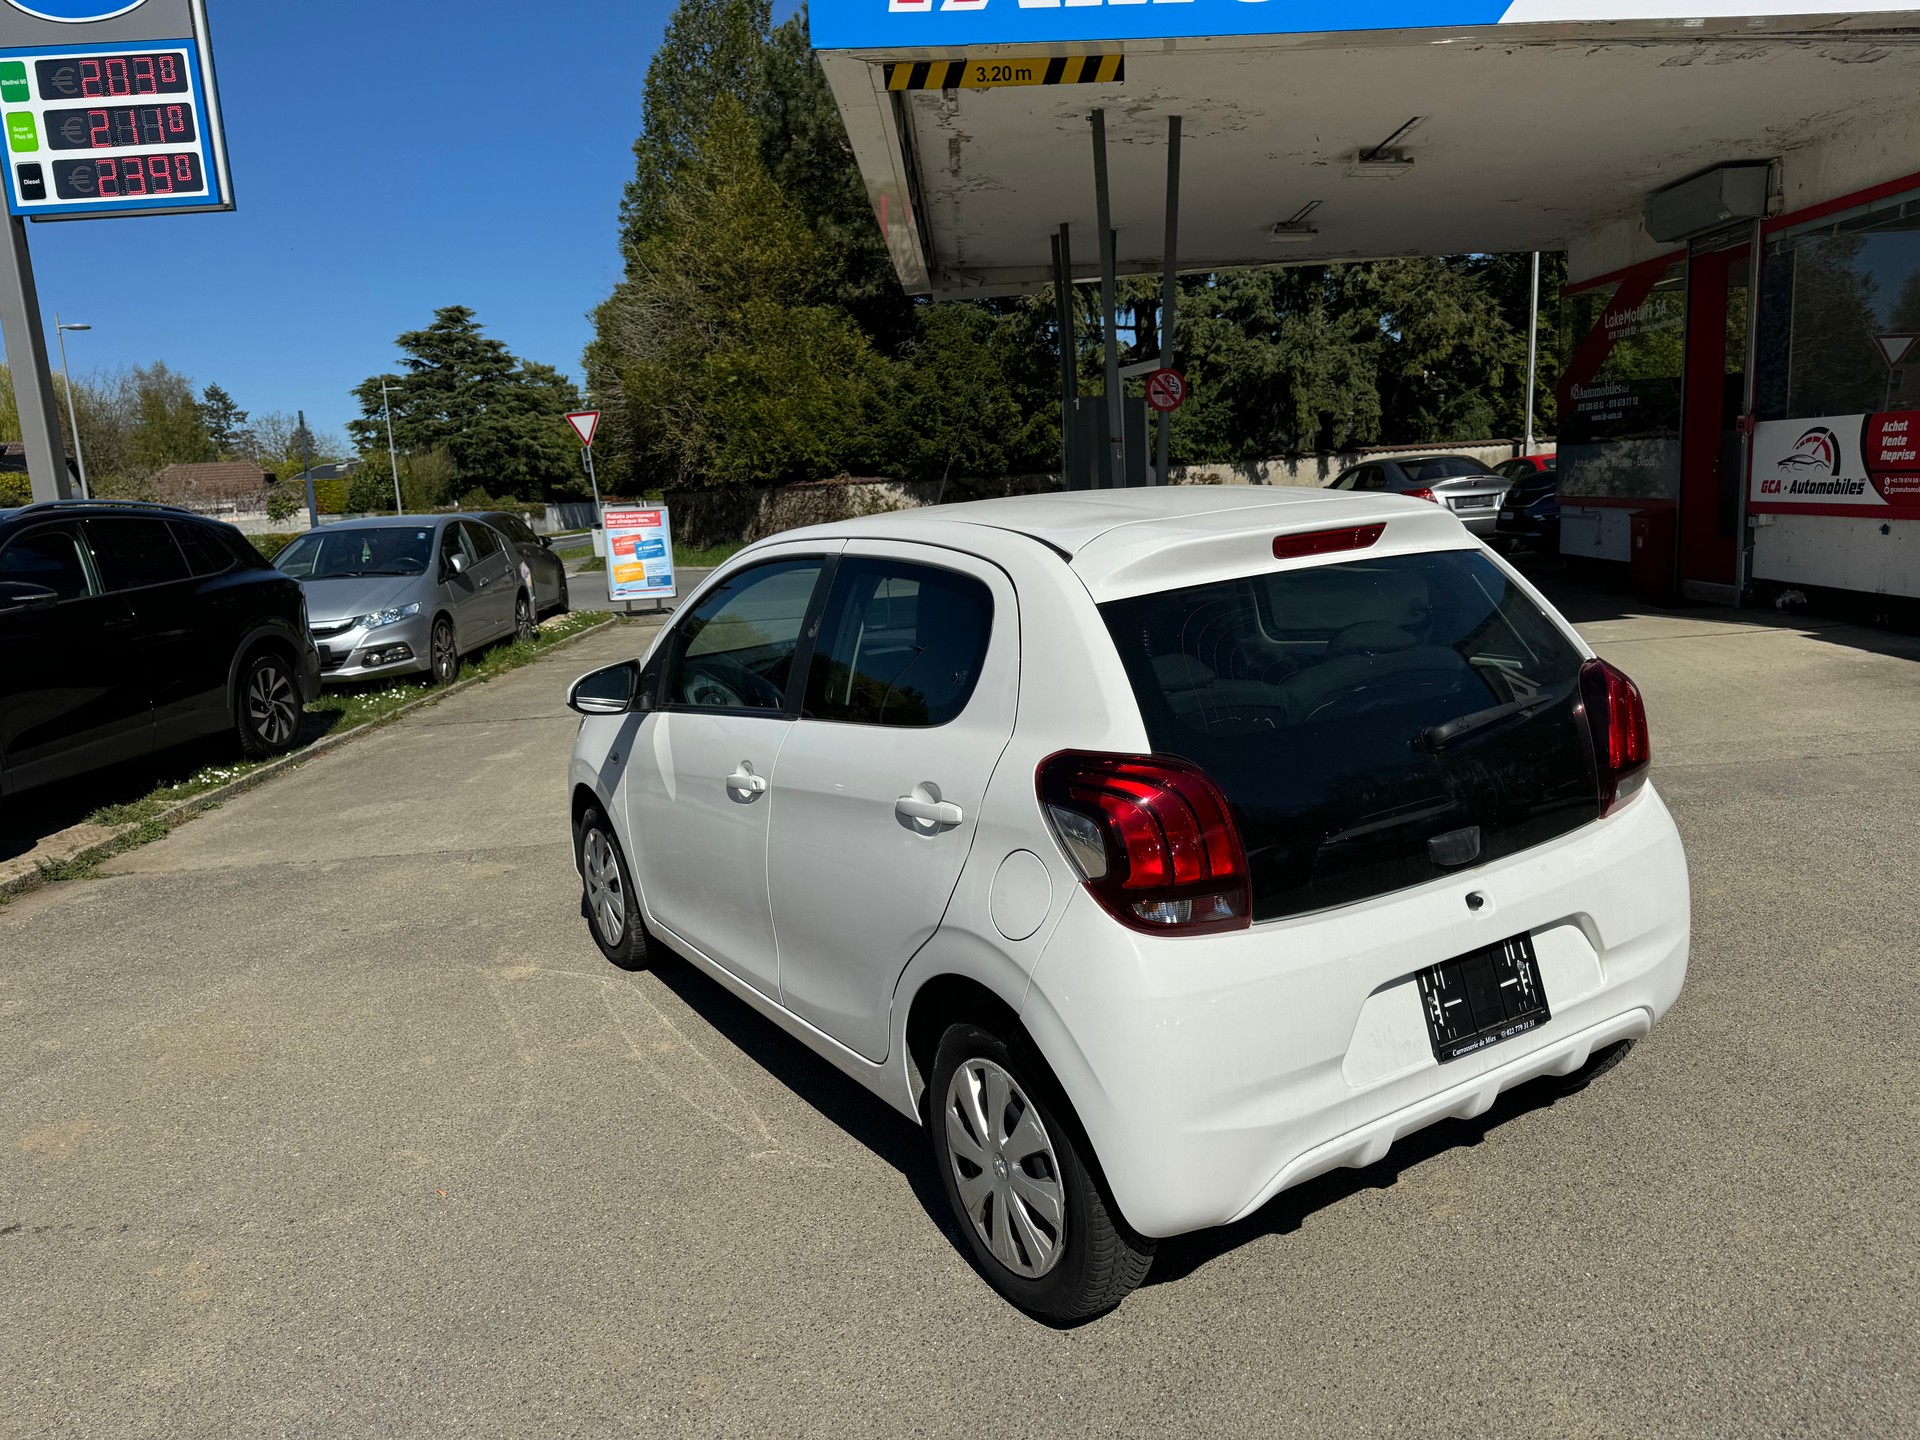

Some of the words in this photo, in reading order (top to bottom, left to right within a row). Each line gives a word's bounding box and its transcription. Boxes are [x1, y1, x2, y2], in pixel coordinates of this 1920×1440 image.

[975, 66, 1013, 83] 3.20
[1015, 68, 1032, 81] m
[1604, 304, 1653, 329] LakeMotors
[1655, 299, 1667, 317] SA
[1578, 381, 1622, 399] Automobiles
[1881, 420, 1909, 433] Achat
[1881, 435, 1908, 447] Vente
[1880, 449, 1917, 463] Reprise
[1760, 480, 1781, 494] GCA
[1789, 478, 1865, 495] Automobiles
[1479, 1039, 1485, 1047] de
[1484, 1035, 1497, 1045] Mies
